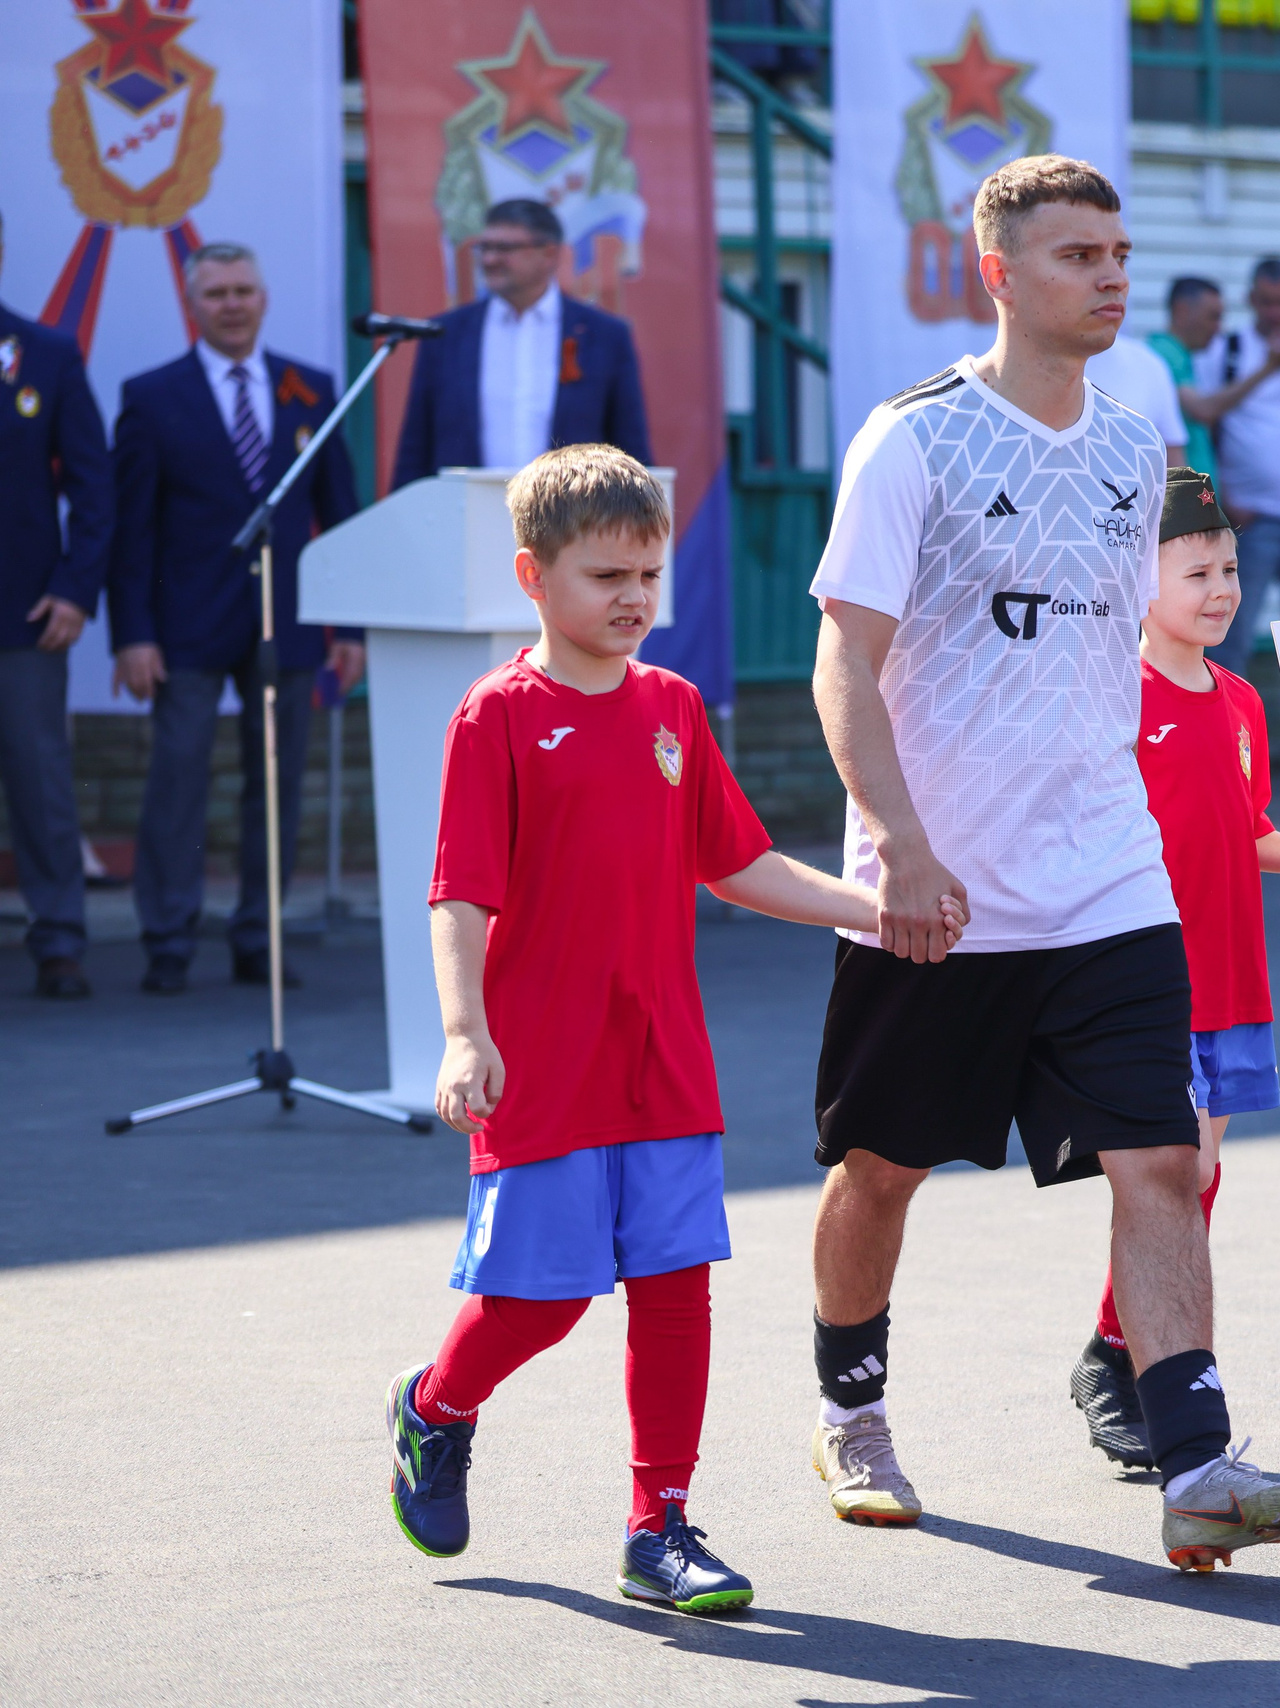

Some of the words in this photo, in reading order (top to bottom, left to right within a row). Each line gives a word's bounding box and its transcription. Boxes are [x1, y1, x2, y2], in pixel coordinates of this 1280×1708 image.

[1051, 599, 1087, 615] Coin
[1091, 600, 1110, 617] Tab
[474, 1186, 498, 1257] 5
